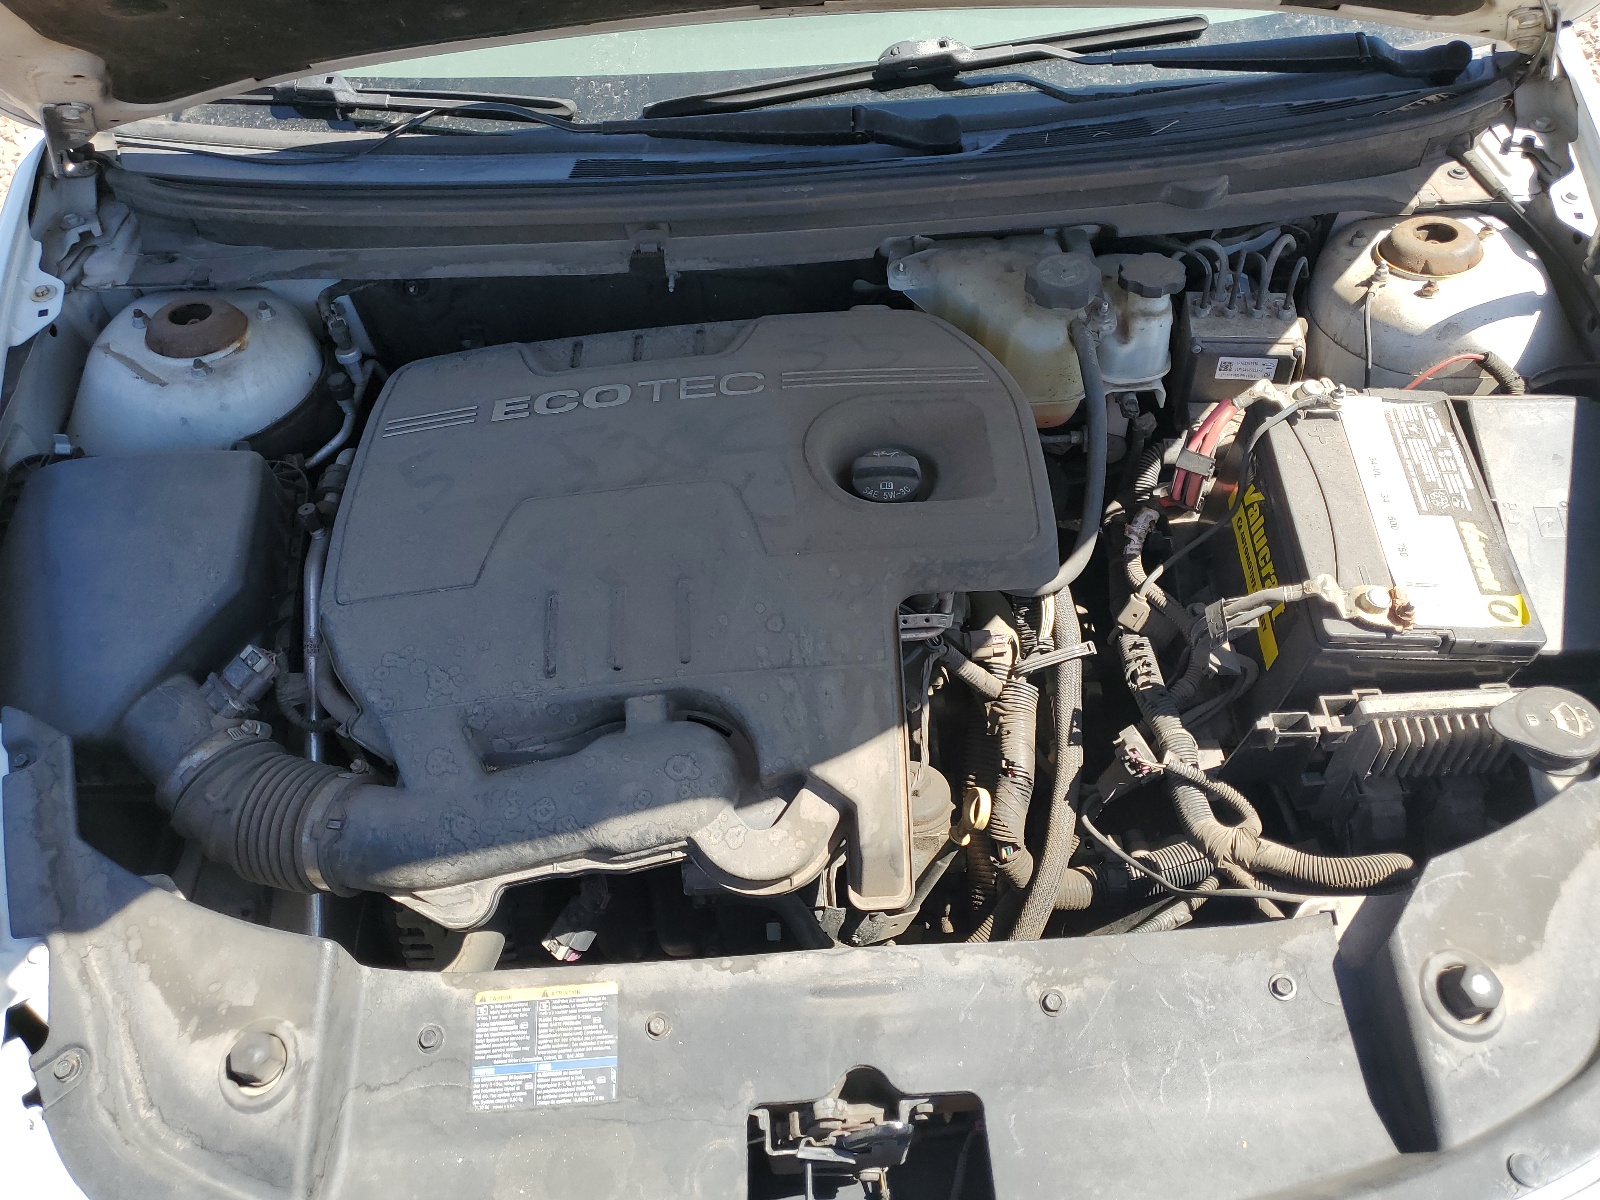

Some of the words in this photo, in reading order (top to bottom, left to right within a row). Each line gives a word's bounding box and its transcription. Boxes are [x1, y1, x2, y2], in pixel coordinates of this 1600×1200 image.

[491, 372, 765, 422] ECOTEC
[863, 486, 879, 498] SAE
[1243, 483, 1286, 621] Valucrat
